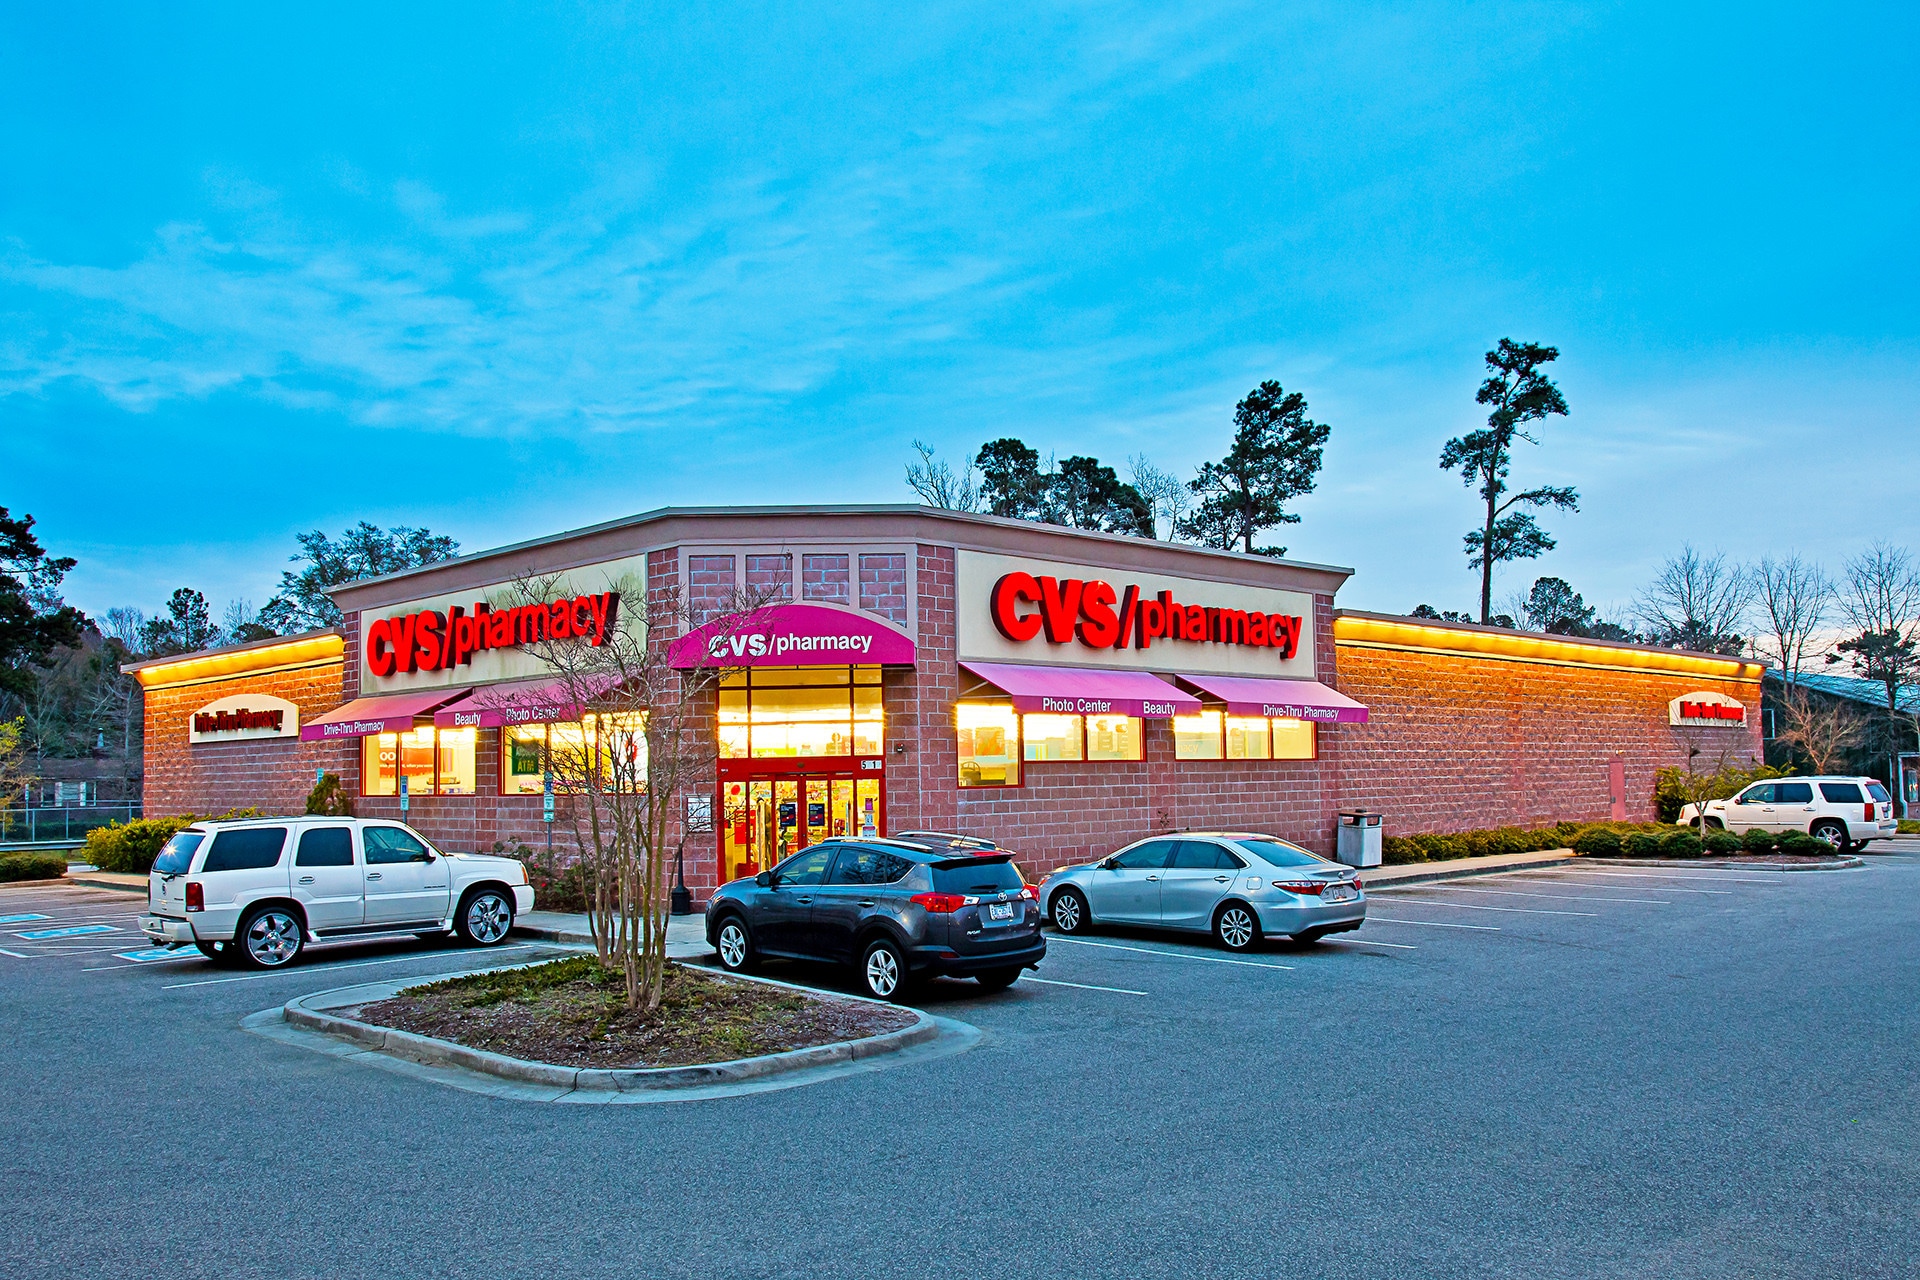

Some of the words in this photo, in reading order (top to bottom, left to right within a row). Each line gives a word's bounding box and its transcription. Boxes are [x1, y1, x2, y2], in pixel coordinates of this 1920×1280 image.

[996, 572, 1303, 659] CVS/pharmacy
[367, 592, 613, 676] CVS/pharmacy
[708, 633, 873, 658] CVS/pharmacy
[1043, 698, 1074, 712] Photo
[1077, 698, 1112, 713] Center
[1143, 701, 1176, 717] Beauty
[1263, 704, 1302, 717] Drive-Thru
[1304, 707, 1340, 720] Pharmacy
[455, 712, 482, 727] Beauty
[506, 708, 530, 721] Photo
[324, 722, 353, 736] Drive-Thru
[354, 720, 385, 733] Pharmacy
